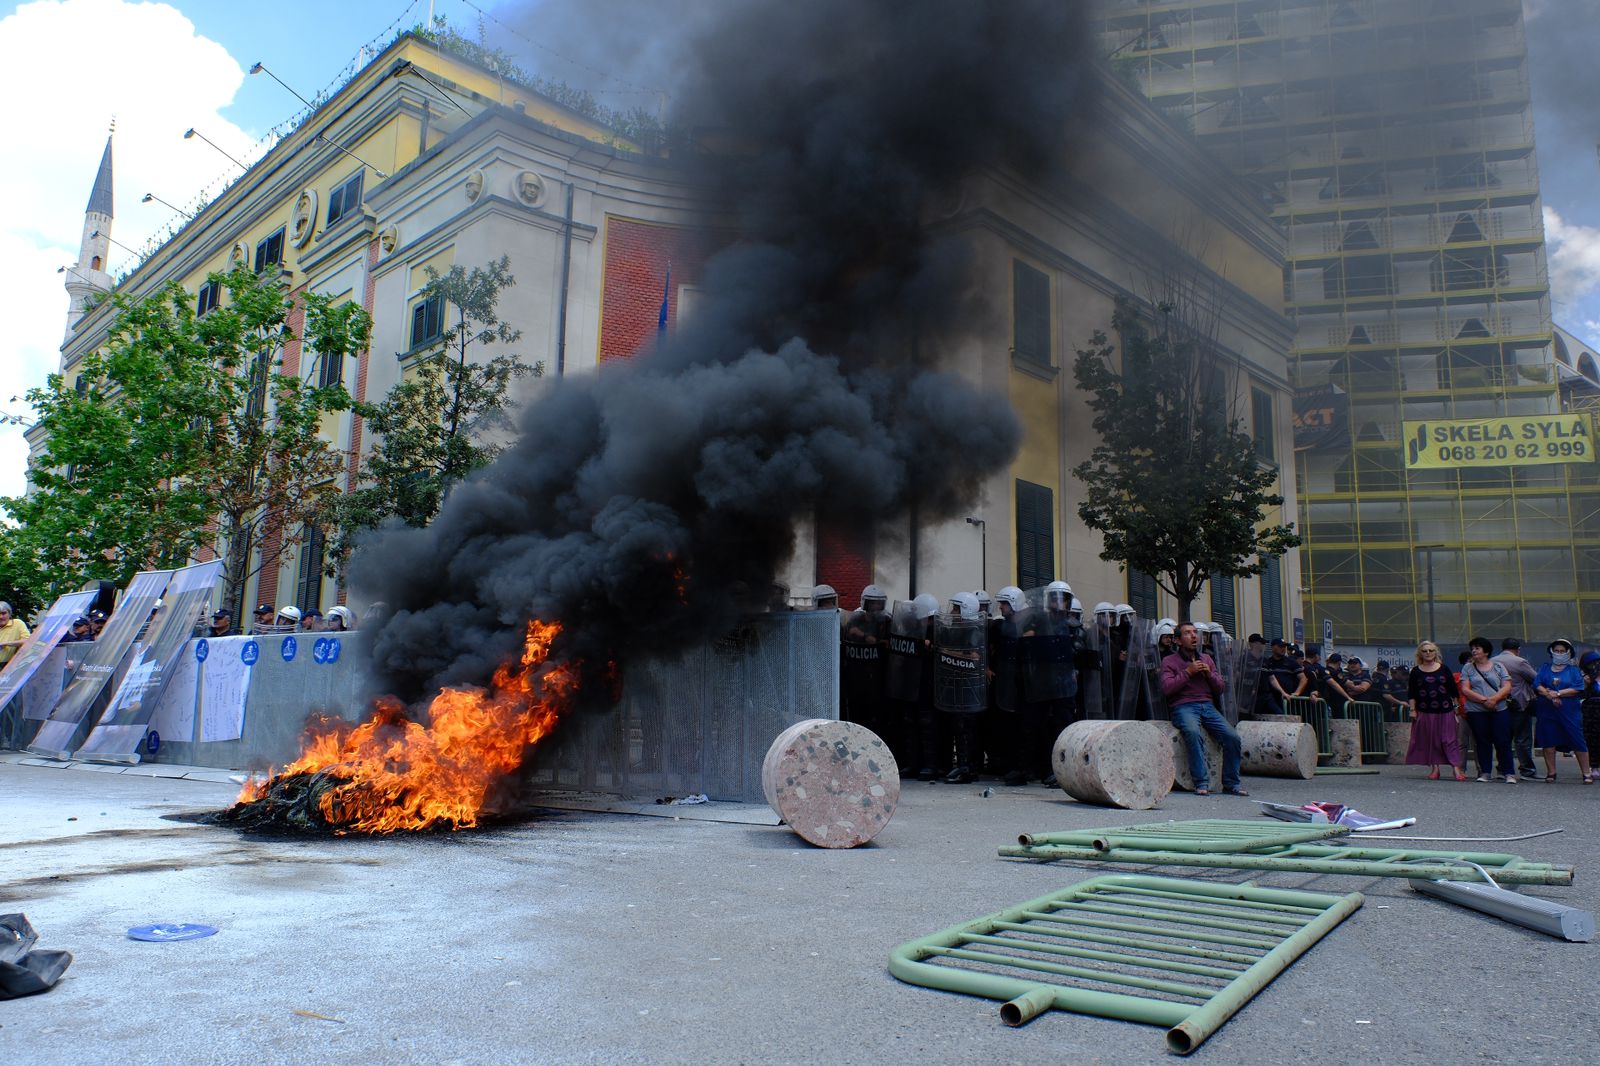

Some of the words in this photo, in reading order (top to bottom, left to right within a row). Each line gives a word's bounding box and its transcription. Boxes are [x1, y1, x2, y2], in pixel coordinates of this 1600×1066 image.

[1434, 424, 1513, 443] SKELA
[1521, 420, 1587, 440] SYLA
[1439, 444, 1476, 461] 068
[1482, 443, 1508, 460] 20
[1514, 442, 1540, 458] 62
[1547, 440, 1585, 457] 999
[846, 645, 879, 660] POLICIA
[1377, 647, 1401, 656] Book
[941, 655, 976, 669] POLICIA
